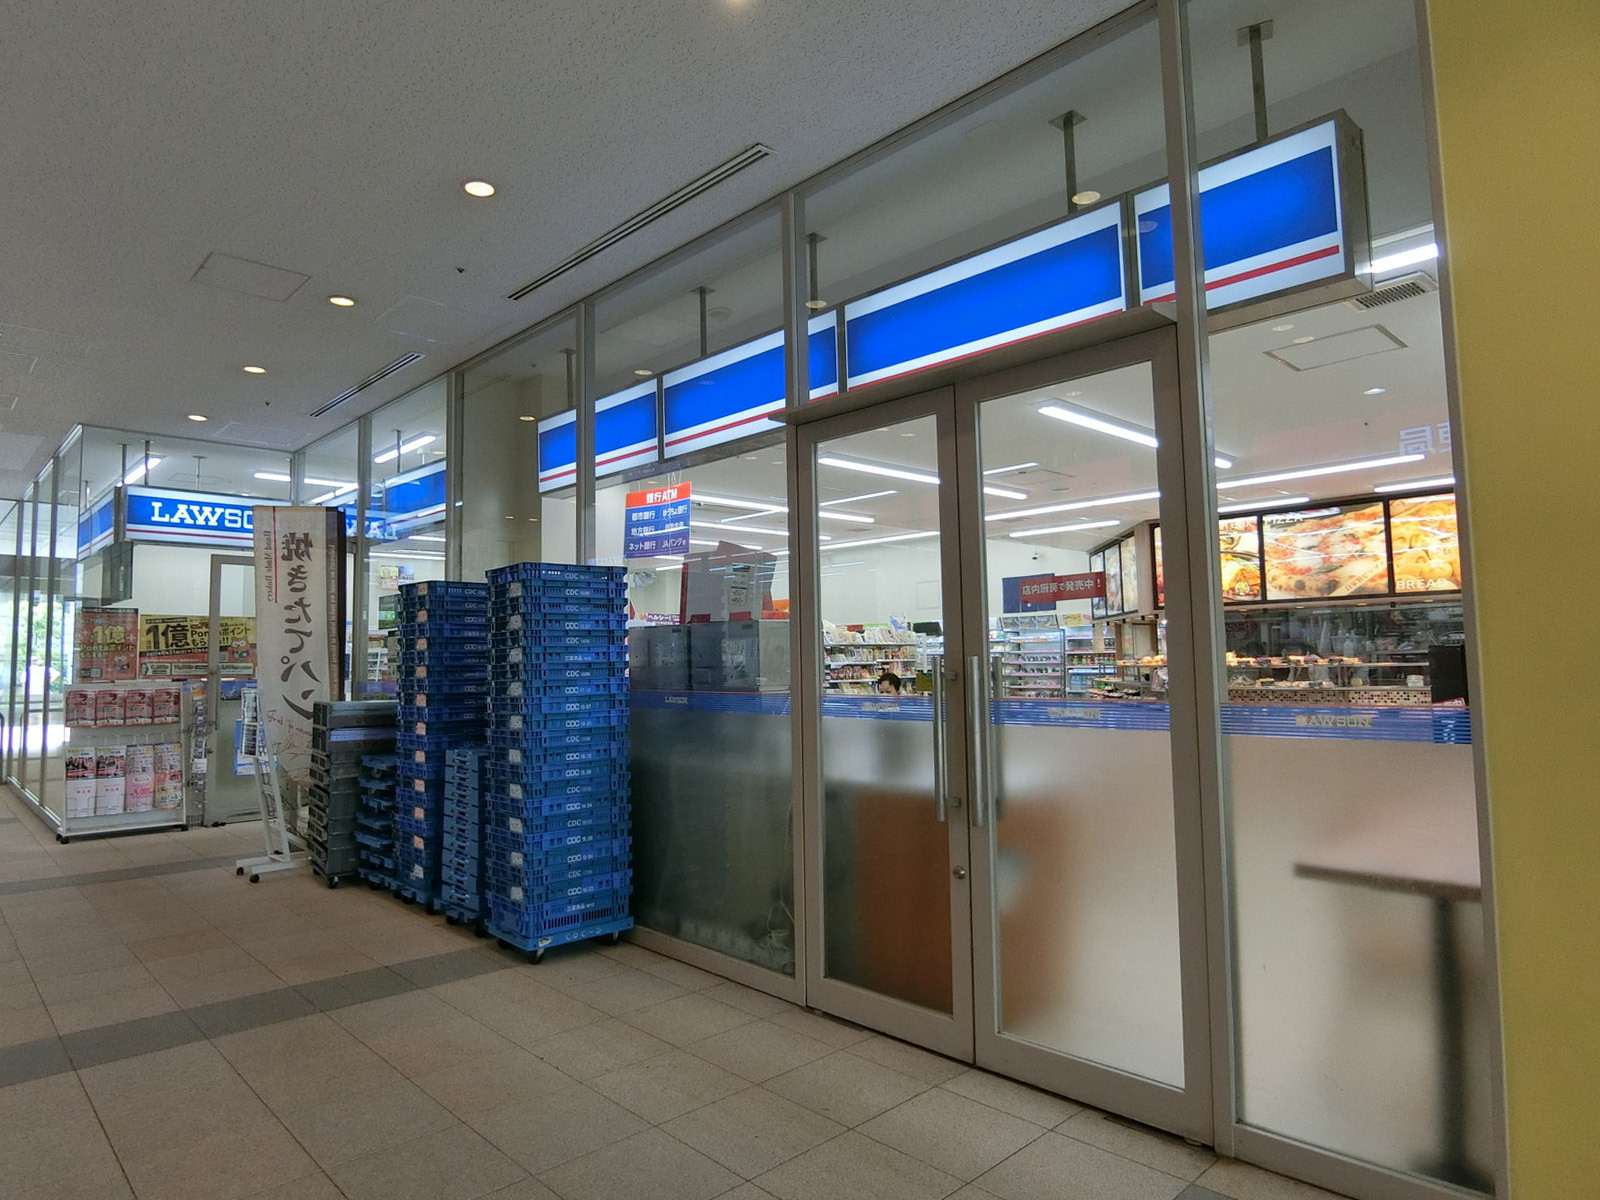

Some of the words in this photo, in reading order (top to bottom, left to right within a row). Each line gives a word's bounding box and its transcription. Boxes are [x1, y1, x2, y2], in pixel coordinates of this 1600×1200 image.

[646, 488, 678, 504] 銀行ATM
[628, 540, 656, 551] ネット銀行
[1396, 577, 1447, 590] BREAD
[145, 623, 190, 650] 1億
